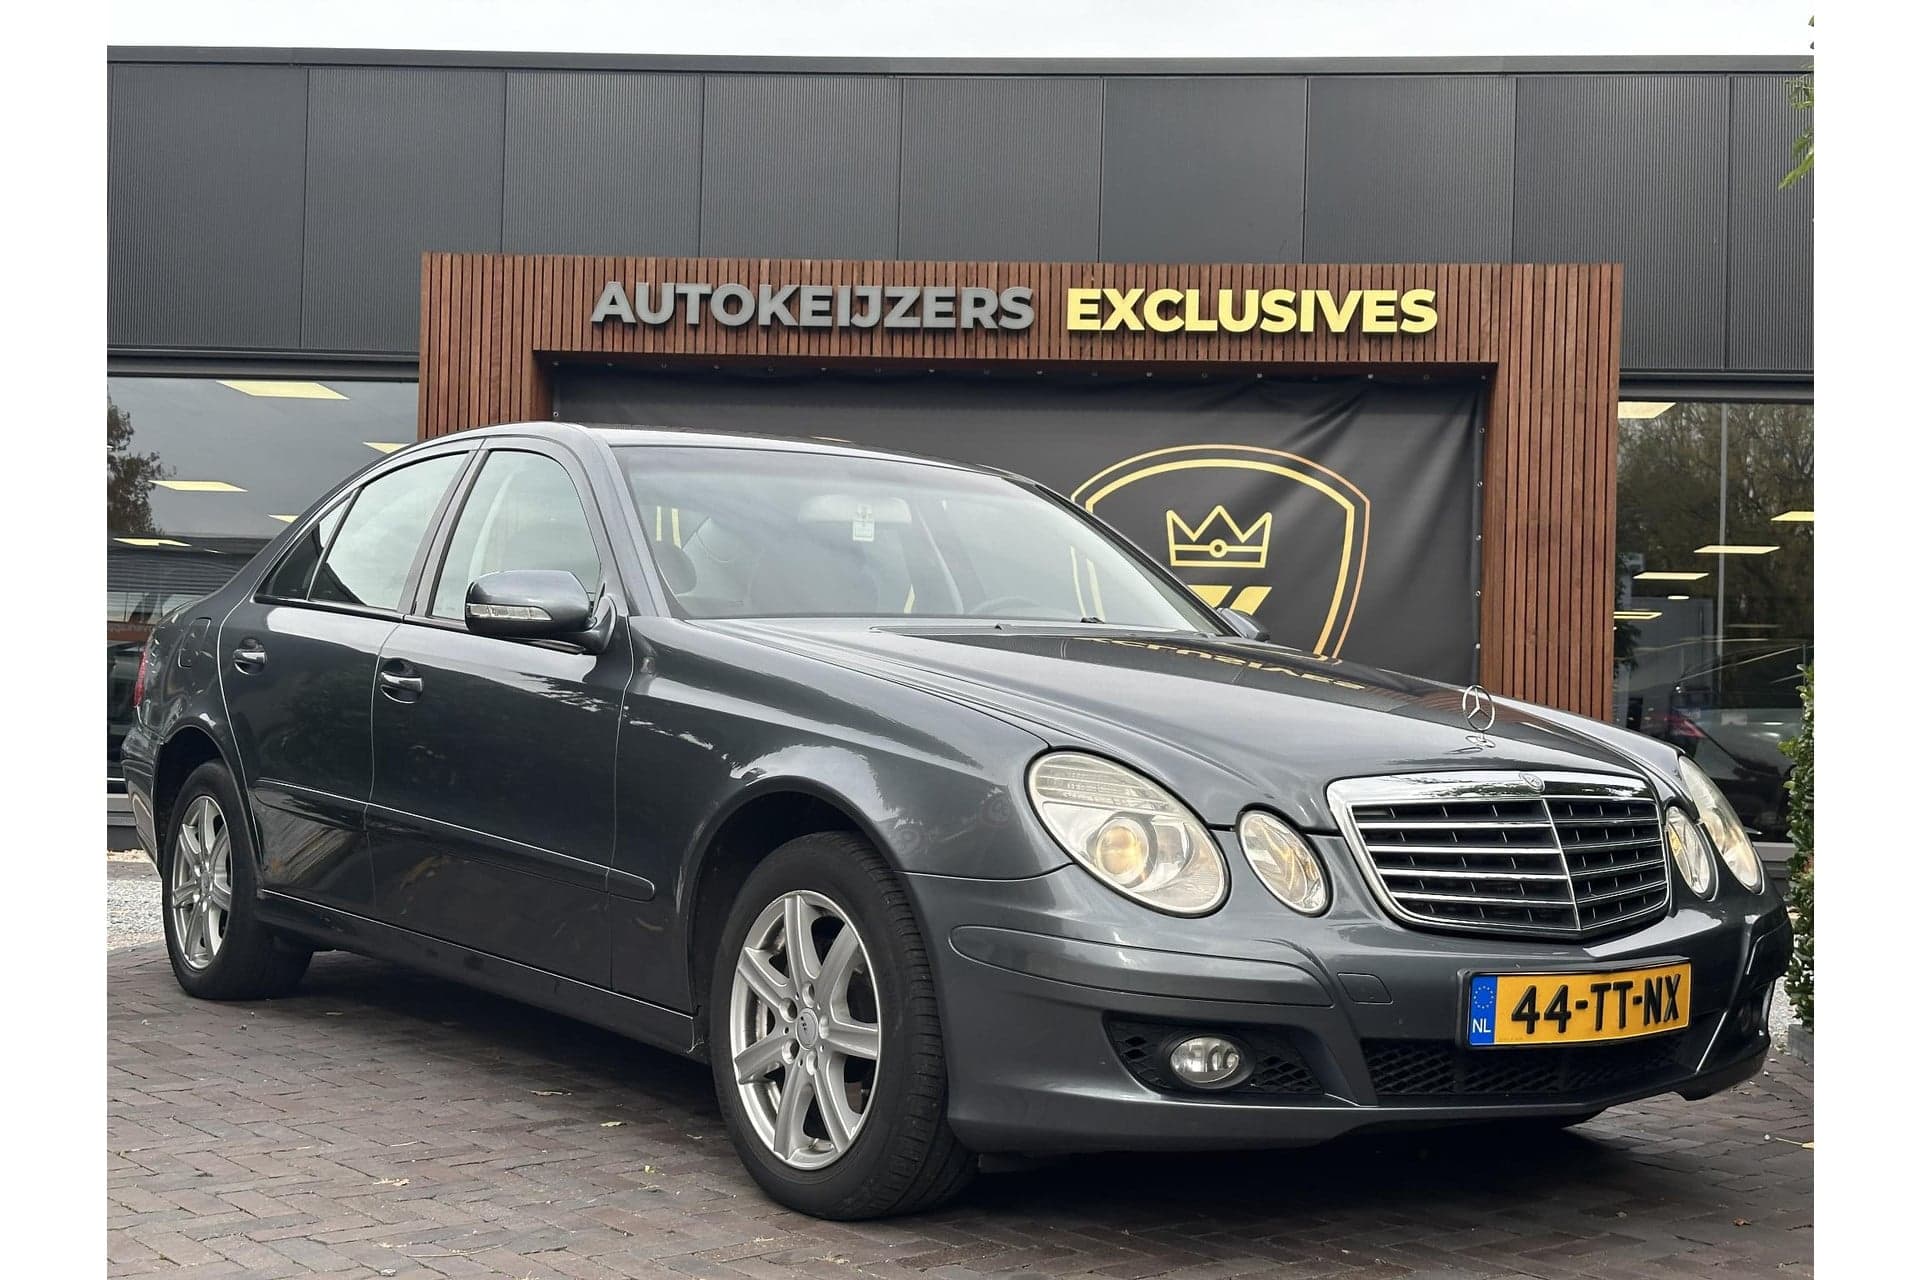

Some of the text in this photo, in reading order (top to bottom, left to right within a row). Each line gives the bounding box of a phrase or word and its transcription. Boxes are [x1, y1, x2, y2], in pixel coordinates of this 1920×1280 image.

[590, 281, 1438, 333] AUTOKEIJZERS EXCLUSIVES
[1472, 974, 1681, 1034] NL 44-TT-NX
